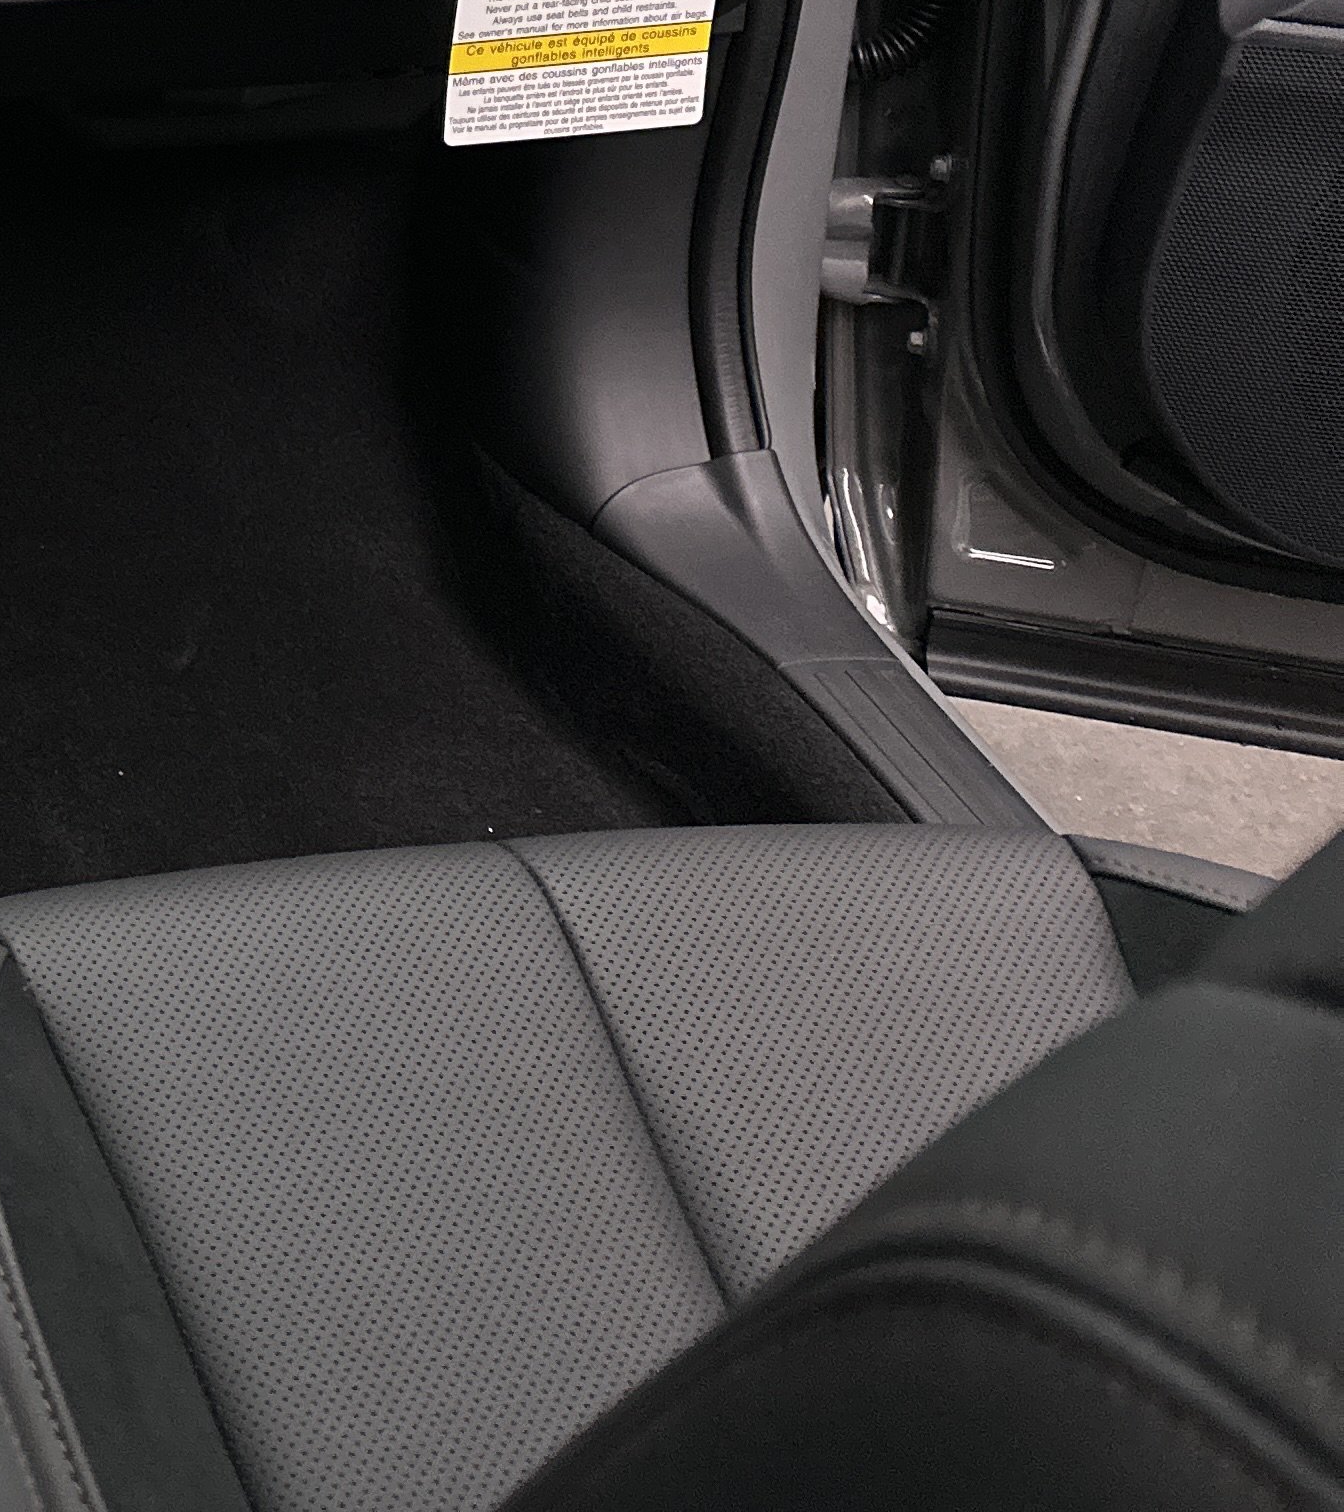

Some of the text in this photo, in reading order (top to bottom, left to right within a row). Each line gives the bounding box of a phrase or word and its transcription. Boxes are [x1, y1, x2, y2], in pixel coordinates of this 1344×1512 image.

[465, 26, 697, 57] Ce véhicule est équipé de coussins
[510, 43, 650, 68] gonflables intelligents
[489, 74, 515, 84] avec
[518, 71, 538, 81] des
[541, 67, 587, 80] coussins
[591, 61, 645, 77] gonflables
